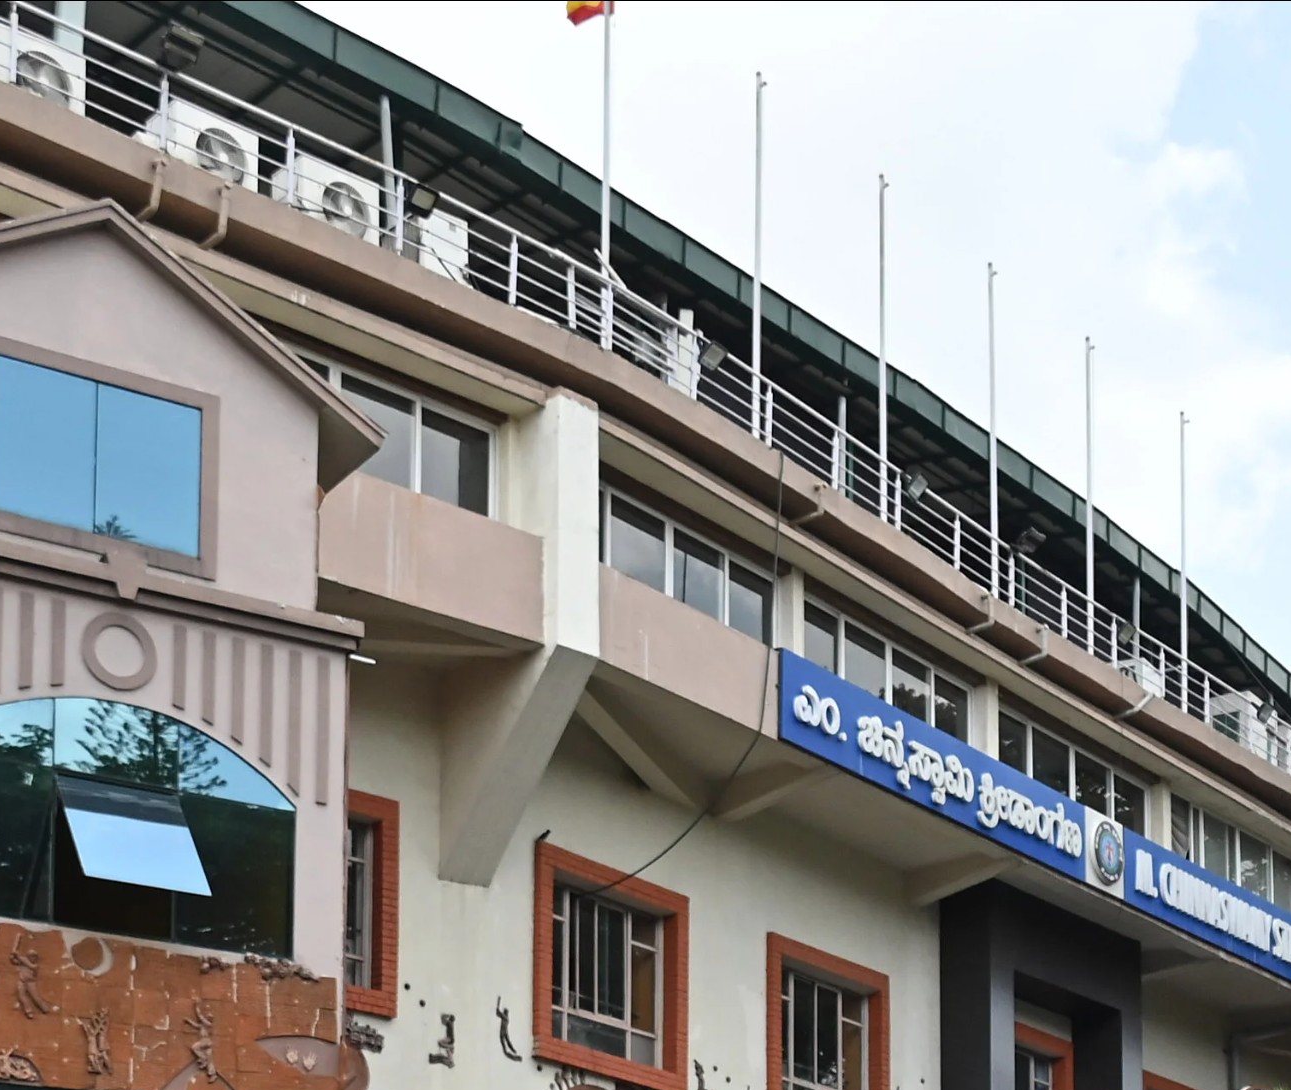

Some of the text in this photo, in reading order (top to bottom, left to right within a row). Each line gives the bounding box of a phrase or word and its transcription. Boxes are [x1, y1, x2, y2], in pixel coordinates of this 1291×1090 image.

[793, 685, 847, 742] ಎಂ.
[857, 716, 974, 805] ಚಿನ್ನಸ್ವಾಮಿ
[977, 773, 1082, 858] ಕ್ರೀಡಾಂಗಣ
[1160, 863, 1272, 952] CHINNASWAMY
